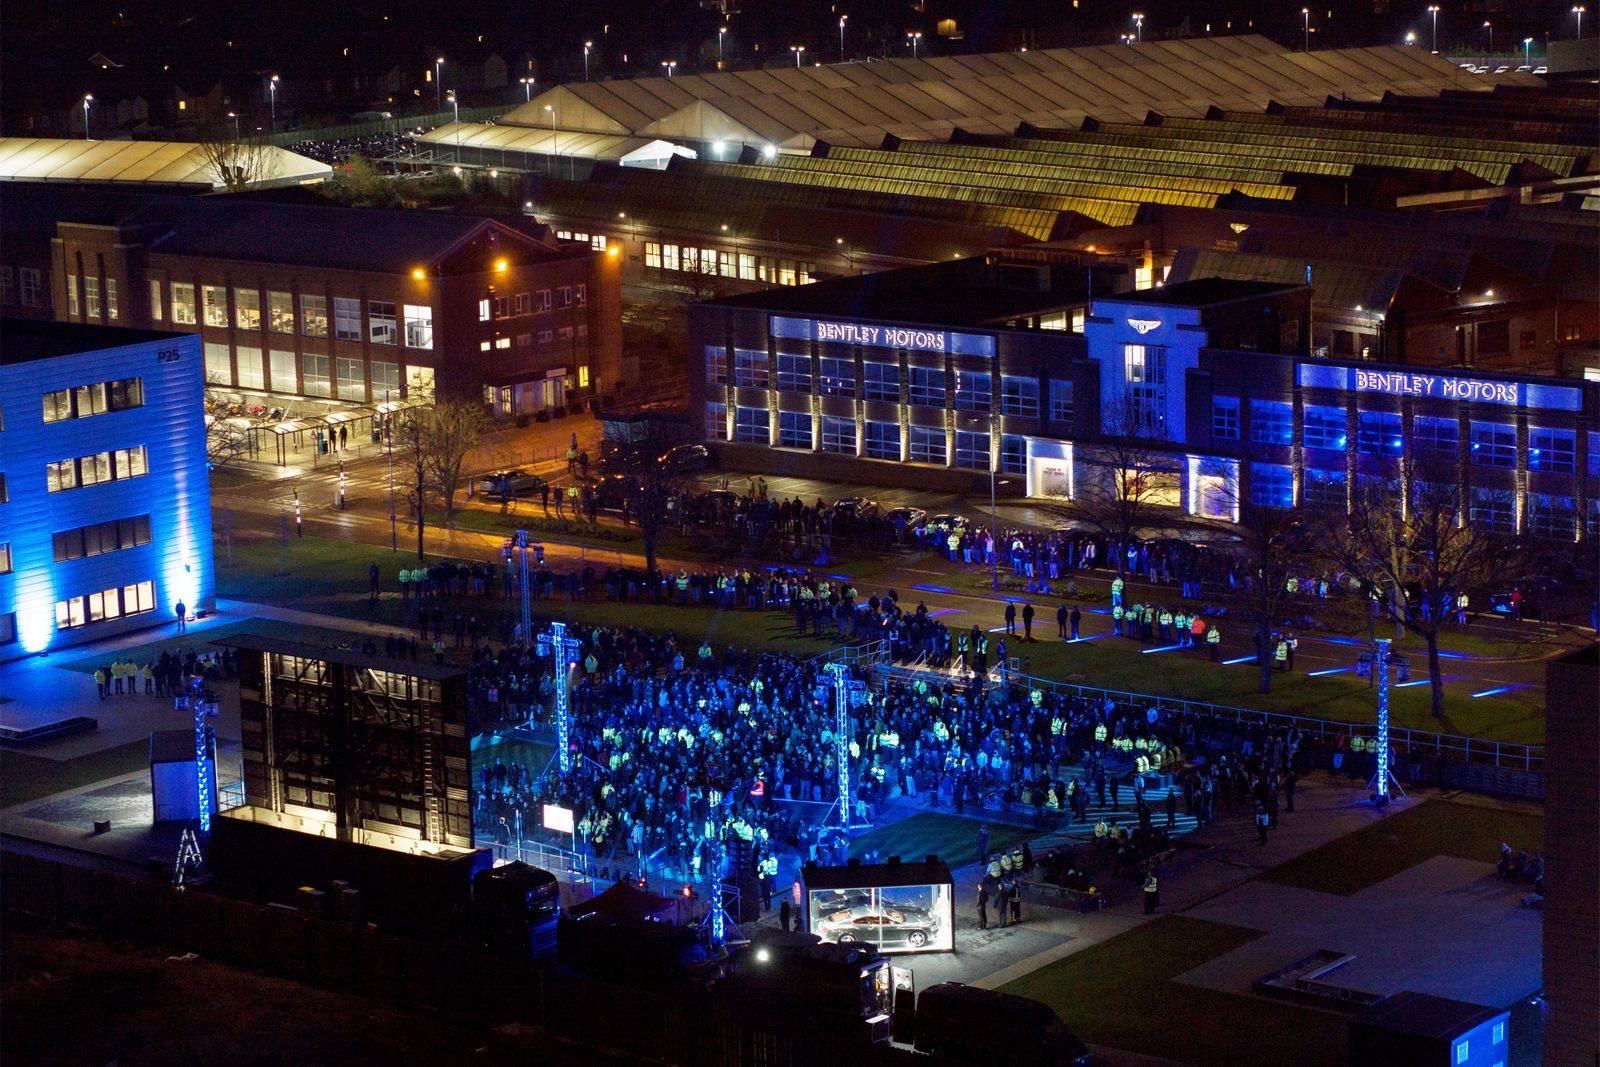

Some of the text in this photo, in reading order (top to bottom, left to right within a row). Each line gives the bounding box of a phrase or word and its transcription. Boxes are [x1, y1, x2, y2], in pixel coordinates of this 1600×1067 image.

[817, 322, 944, 350] BENTLEY MOTORS
[158, 349, 180, 363] P25
[1357, 371, 1518, 402] BENTLEY MOTORS
